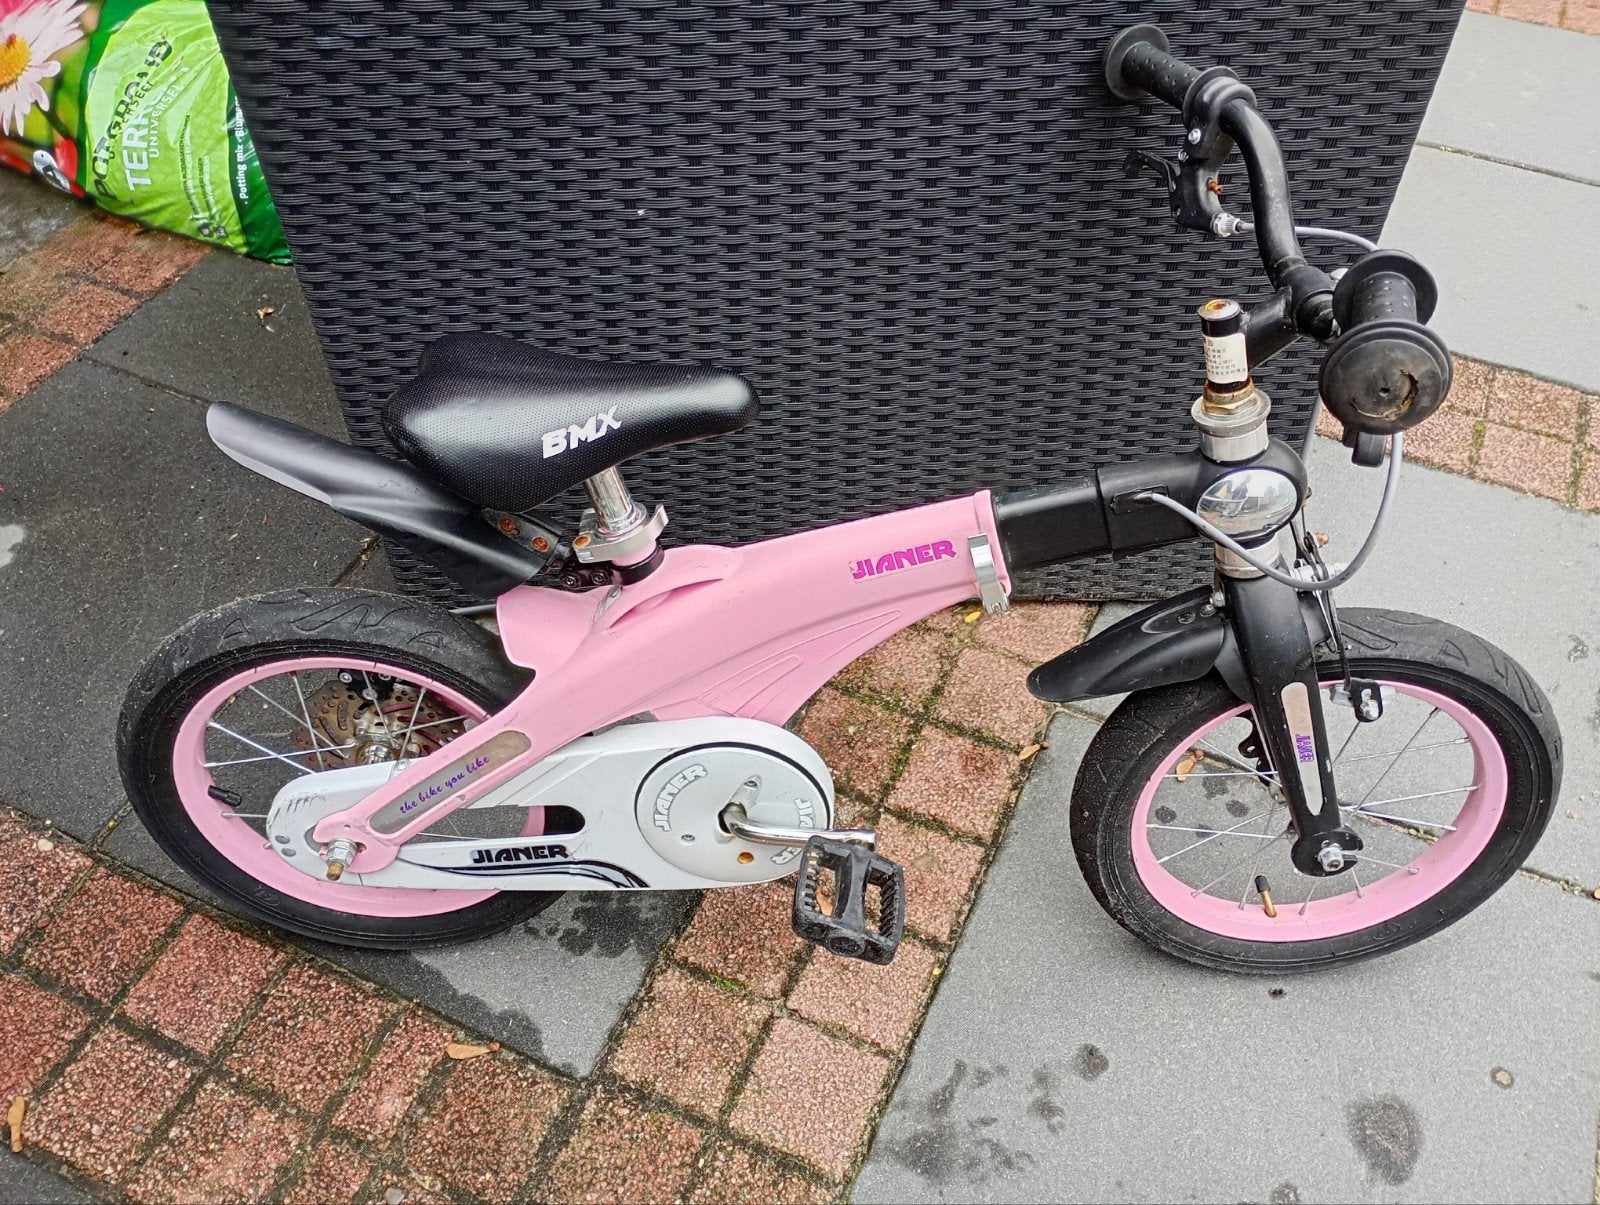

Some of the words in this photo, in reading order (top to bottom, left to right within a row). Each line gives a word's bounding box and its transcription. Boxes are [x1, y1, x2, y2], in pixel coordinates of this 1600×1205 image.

[149, 83, 185, 158] UNIVERSEL
[235, 144, 244, 162] mix
[237, 163, 249, 199] Potting
[541, 405, 622, 459] BMX
[851, 540, 957, 580] JIANER
[399, 799, 418, 814] the
[418, 786, 443, 803] bike
[445, 772, 465, 788] you
[466, 755, 490, 773] like
[653, 763, 709, 832] JIANER
[472, 844, 569, 864] JIANER
